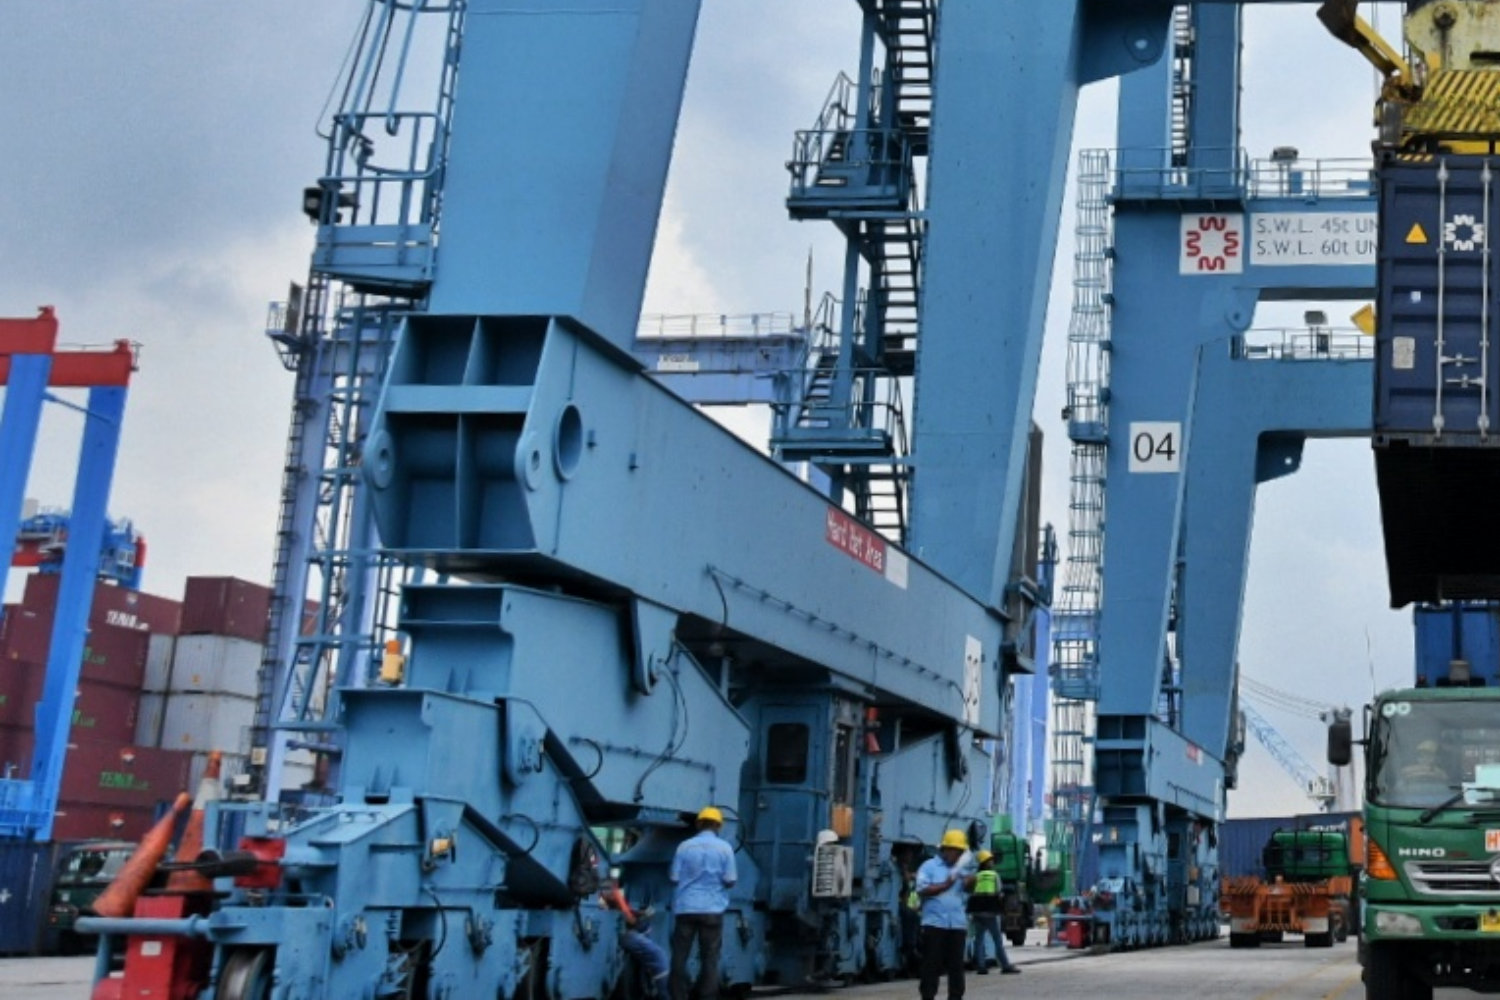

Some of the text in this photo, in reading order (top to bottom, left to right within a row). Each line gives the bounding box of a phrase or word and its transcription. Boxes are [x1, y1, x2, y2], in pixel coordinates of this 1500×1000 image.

[1256, 218, 1313, 233] S.W.L.
[1320, 219, 1350, 233] 45t
[1256, 240, 1312, 255] S.W.L.
[1321, 240, 1350, 255] 60t
[1134, 433, 1176, 462] 04
[1398, 847, 1446, 858] HINO
